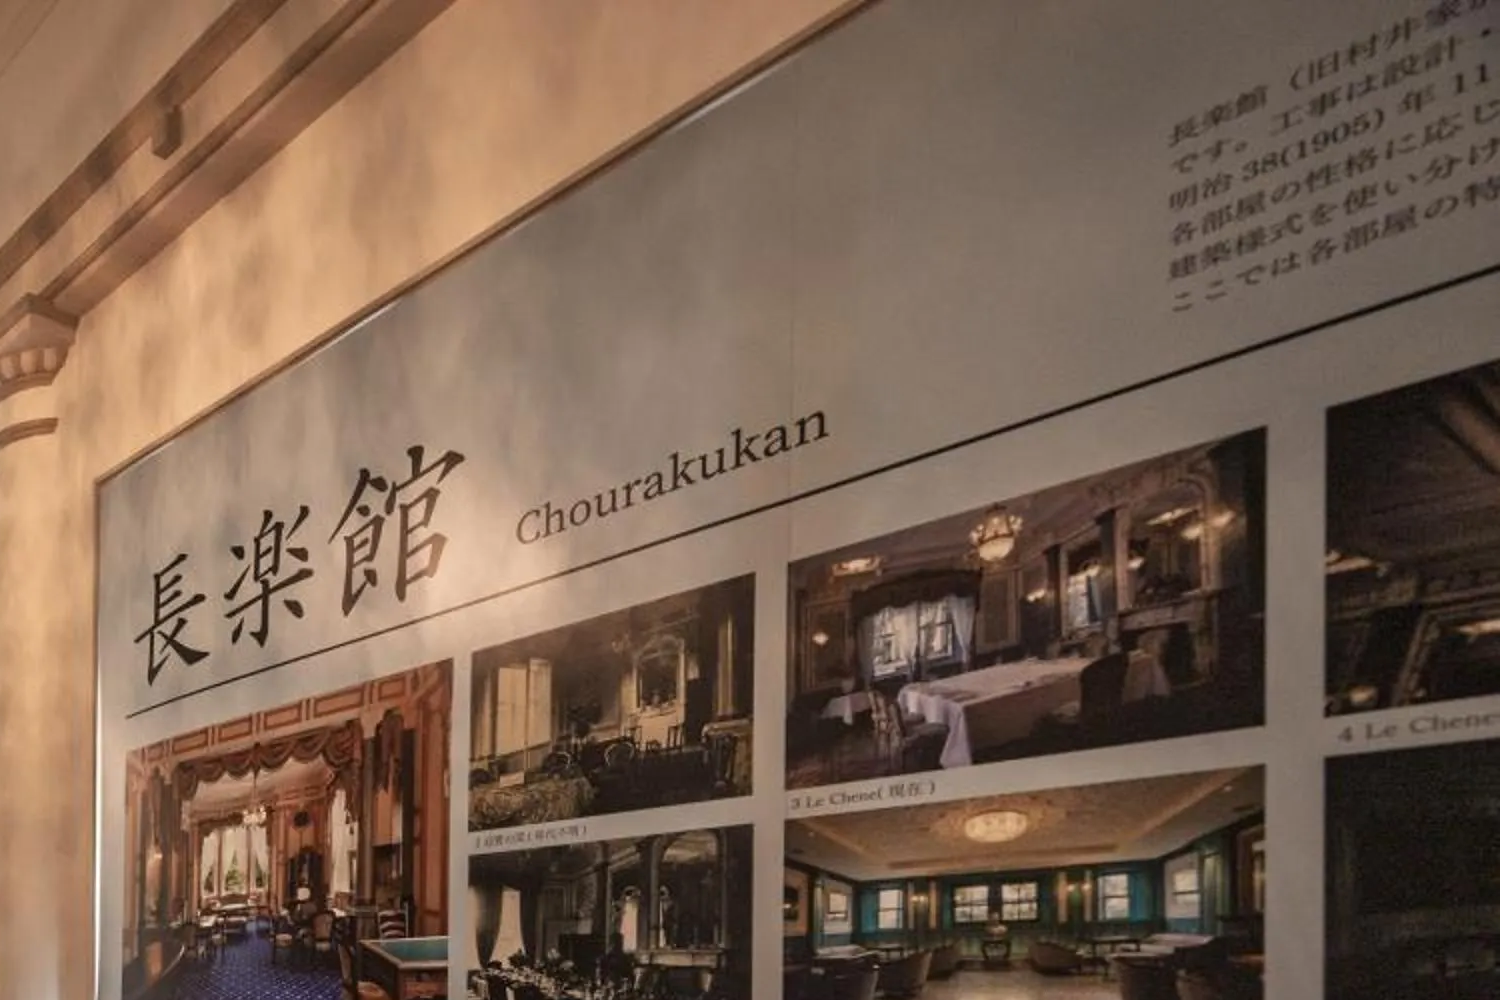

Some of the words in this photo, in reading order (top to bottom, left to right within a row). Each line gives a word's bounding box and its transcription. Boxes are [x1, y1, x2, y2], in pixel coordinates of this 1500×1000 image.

[517, 409, 829, 545] Chourakukan
[133, 445, 465, 687] 長楽館
[1365, 723, 1397, 740] Le
